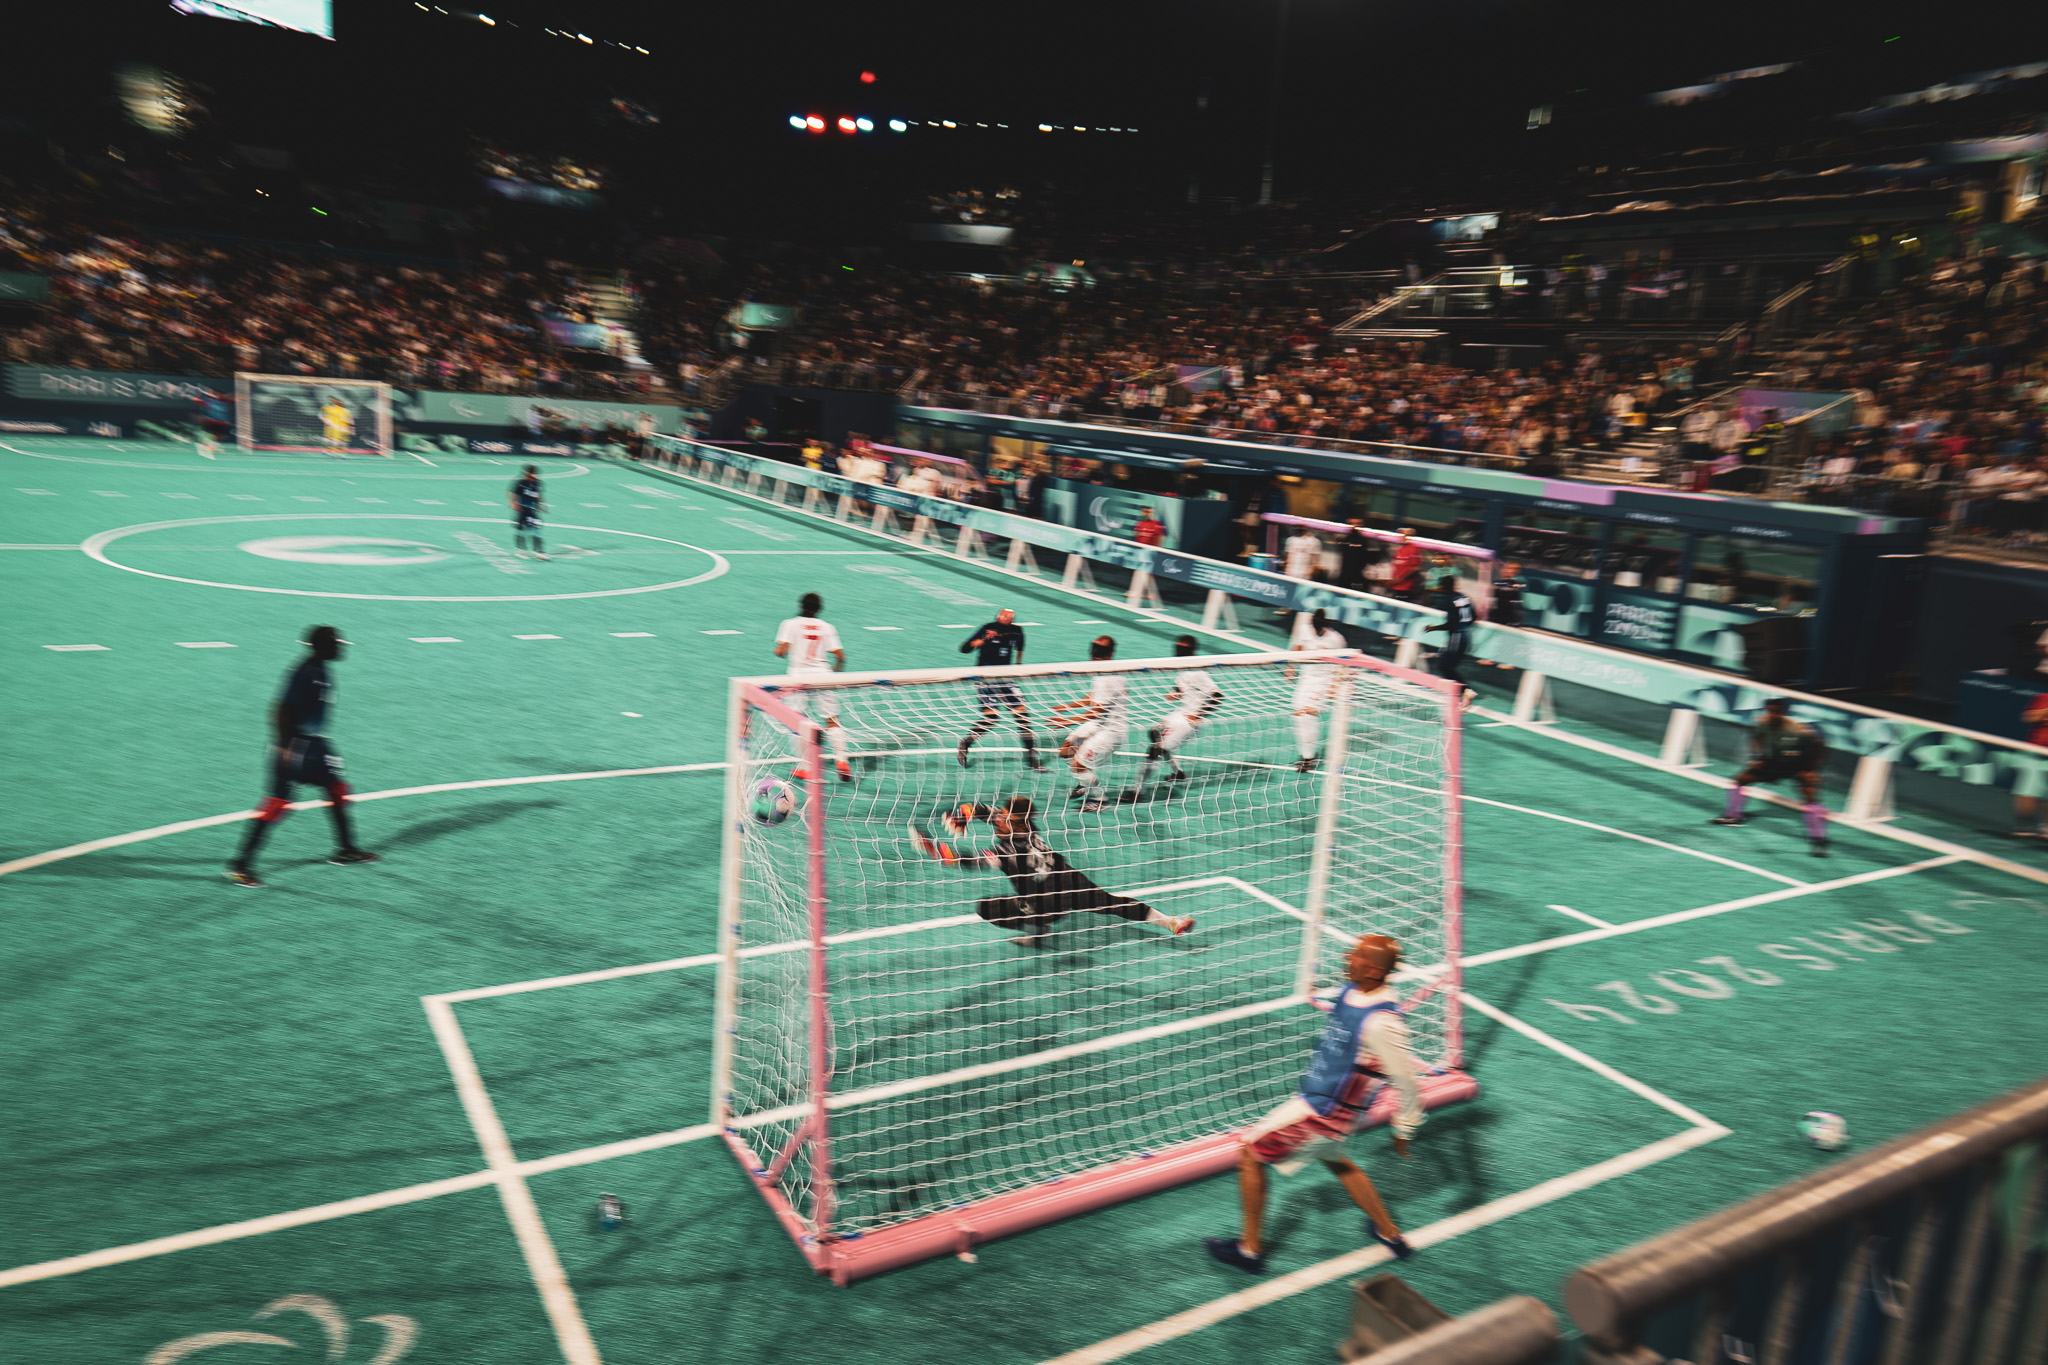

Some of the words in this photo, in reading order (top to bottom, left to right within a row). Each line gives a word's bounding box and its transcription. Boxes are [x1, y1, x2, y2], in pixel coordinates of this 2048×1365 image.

[1606, 603, 1665, 625] PARIS
[1756, 909, 1977, 972] PARIS
[1542, 955, 1785, 1025] 2024
